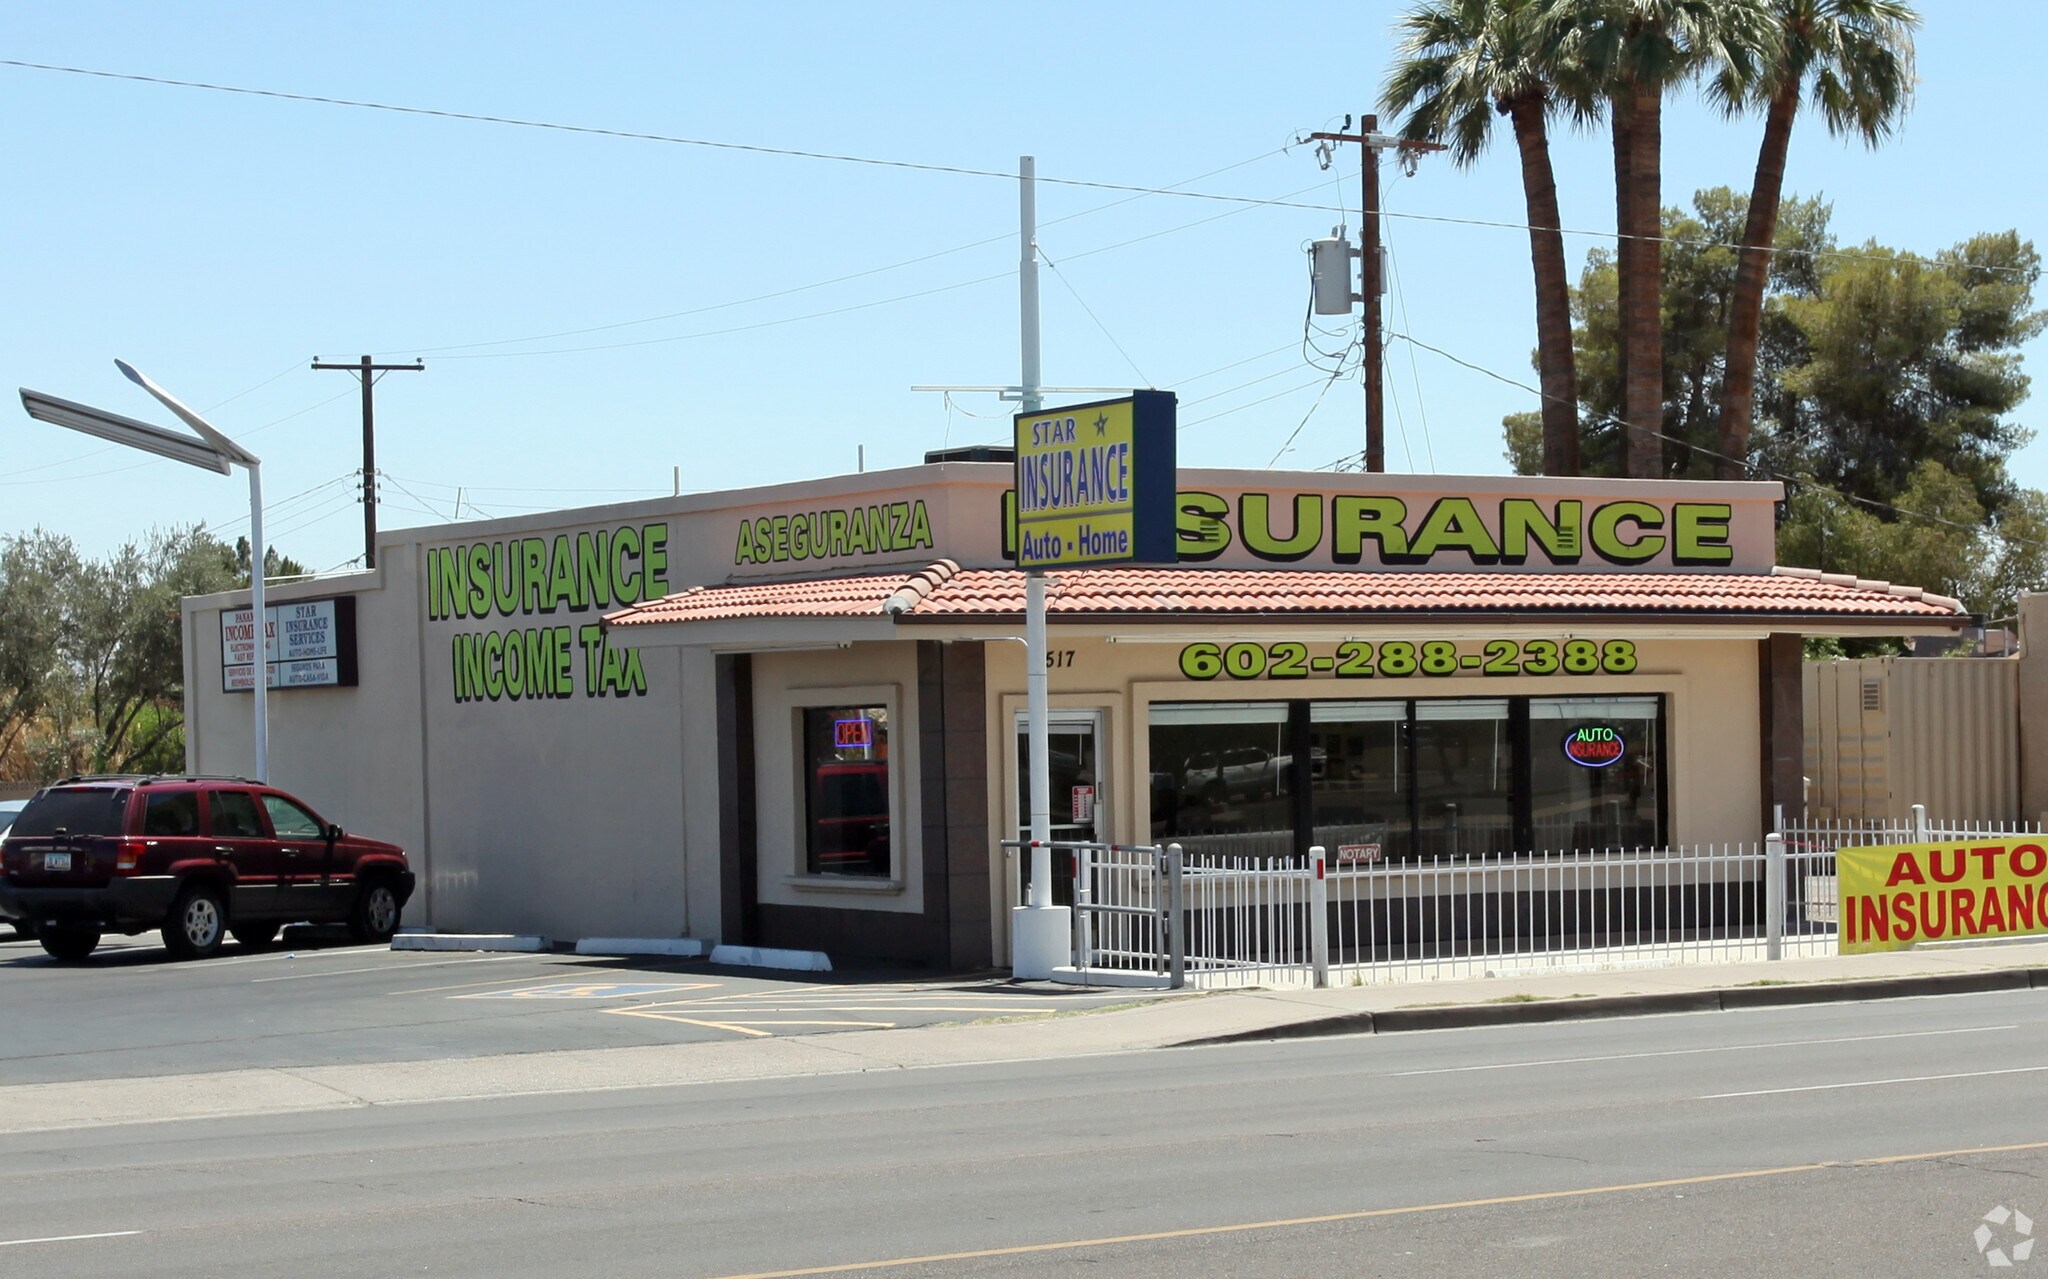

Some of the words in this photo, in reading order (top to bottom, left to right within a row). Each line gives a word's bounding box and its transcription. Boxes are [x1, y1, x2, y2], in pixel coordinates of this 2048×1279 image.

[1032, 418, 1076, 446] STAR
[1020, 442, 1129, 512] INSURANCE
[735, 500, 934, 565] ASEGURANZA
[1002, 489, 1733, 566] SURANCE
[1021, 529, 1062, 561] Auto
[1078, 524, 1128, 556] Home
[426, 523, 669, 621] INSURANCE
[285, 617, 328, 633] INSURANCE
[296, 605, 317, 619] STAR
[225, 624, 254, 641] INCOM
[288, 631, 326, 646] SERVICES
[452, 625, 574, 703] INCOME
[579, 624, 648, 698] TAX
[1179, 640, 1638, 681] 602-288-2388
[1576, 727, 1614, 742] AUTO
[1340, 847, 1379, 860] NOTARY
[1885, 844, 2048, 887] AUTO
